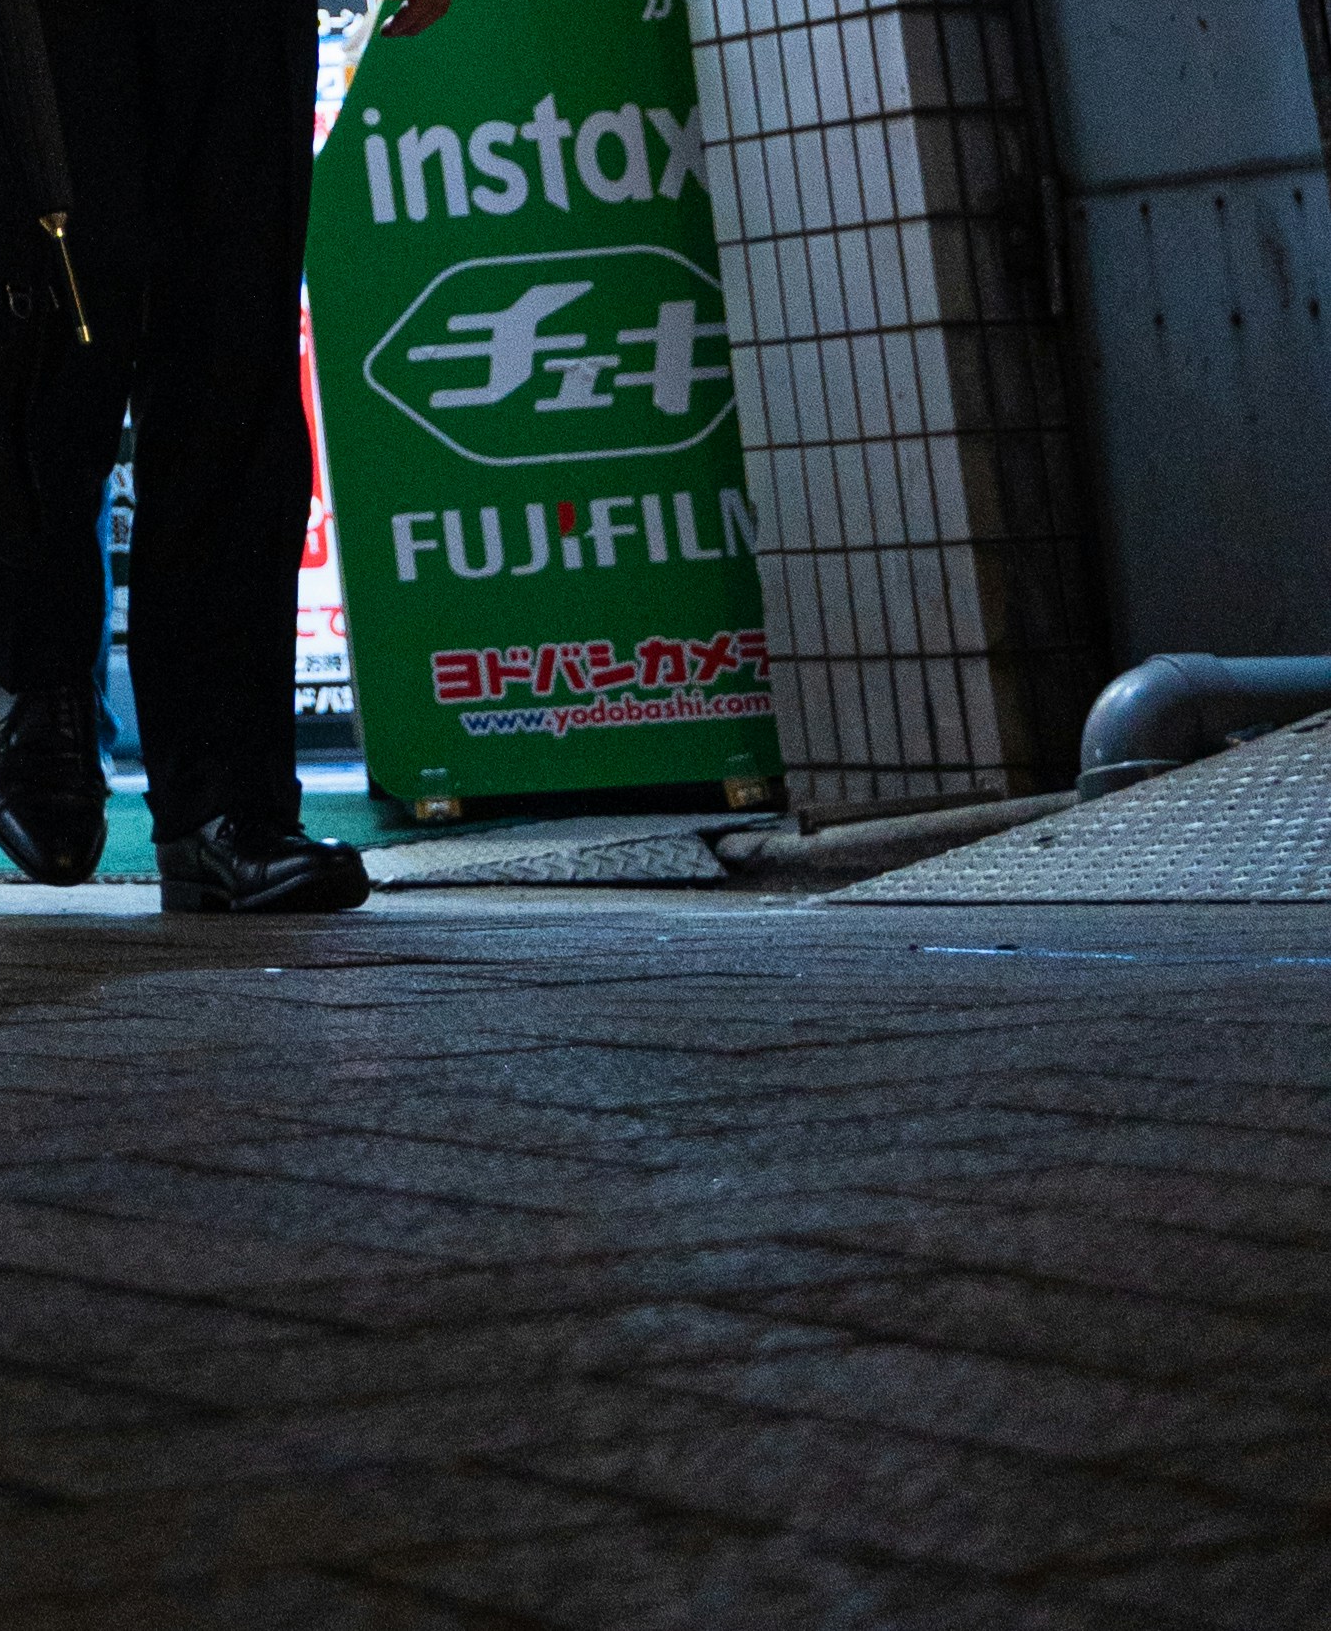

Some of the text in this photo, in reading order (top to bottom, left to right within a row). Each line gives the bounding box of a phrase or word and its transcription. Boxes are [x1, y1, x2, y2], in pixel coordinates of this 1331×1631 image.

[362, 92, 711, 224] instax
[407, 280, 730, 415] チェキ
[432, 630, 770, 704] ヨドバシカメラ
[458, 688, 770, 739] www.yodobashi.com
